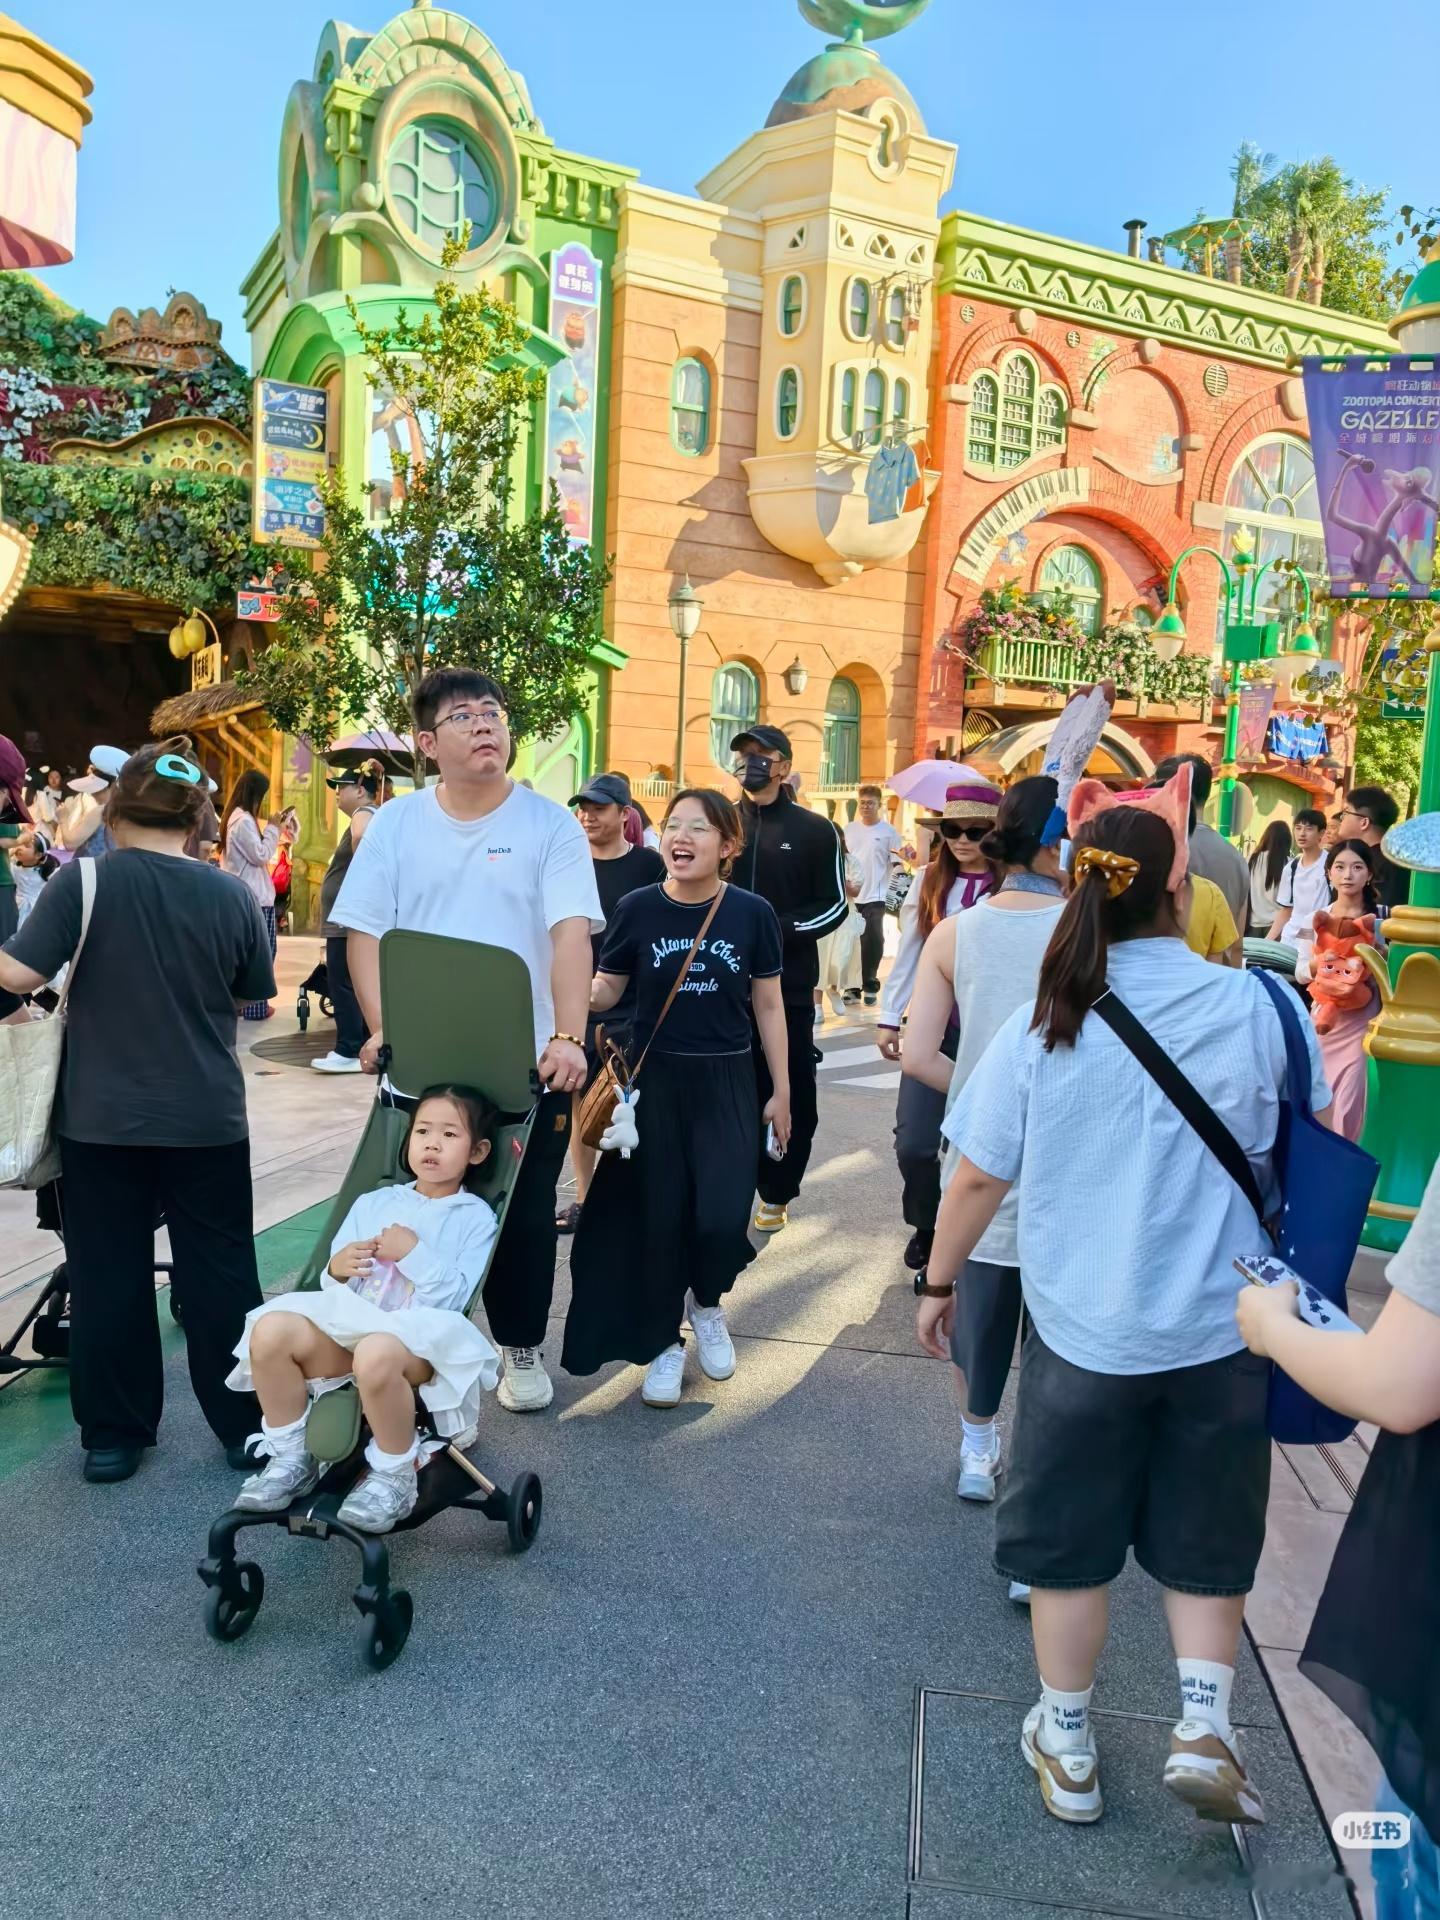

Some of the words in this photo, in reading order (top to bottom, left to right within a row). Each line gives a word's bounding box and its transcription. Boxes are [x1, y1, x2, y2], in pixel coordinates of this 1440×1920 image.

[1342, 396, 1393, 407] ZOOTOPIA
[1394, 395, 1440, 406] CONCERT
[1341, 409, 1440, 432] GAZELLE
[710, 939, 741, 974] Chic
[1199, 1679, 1217, 1693] be
